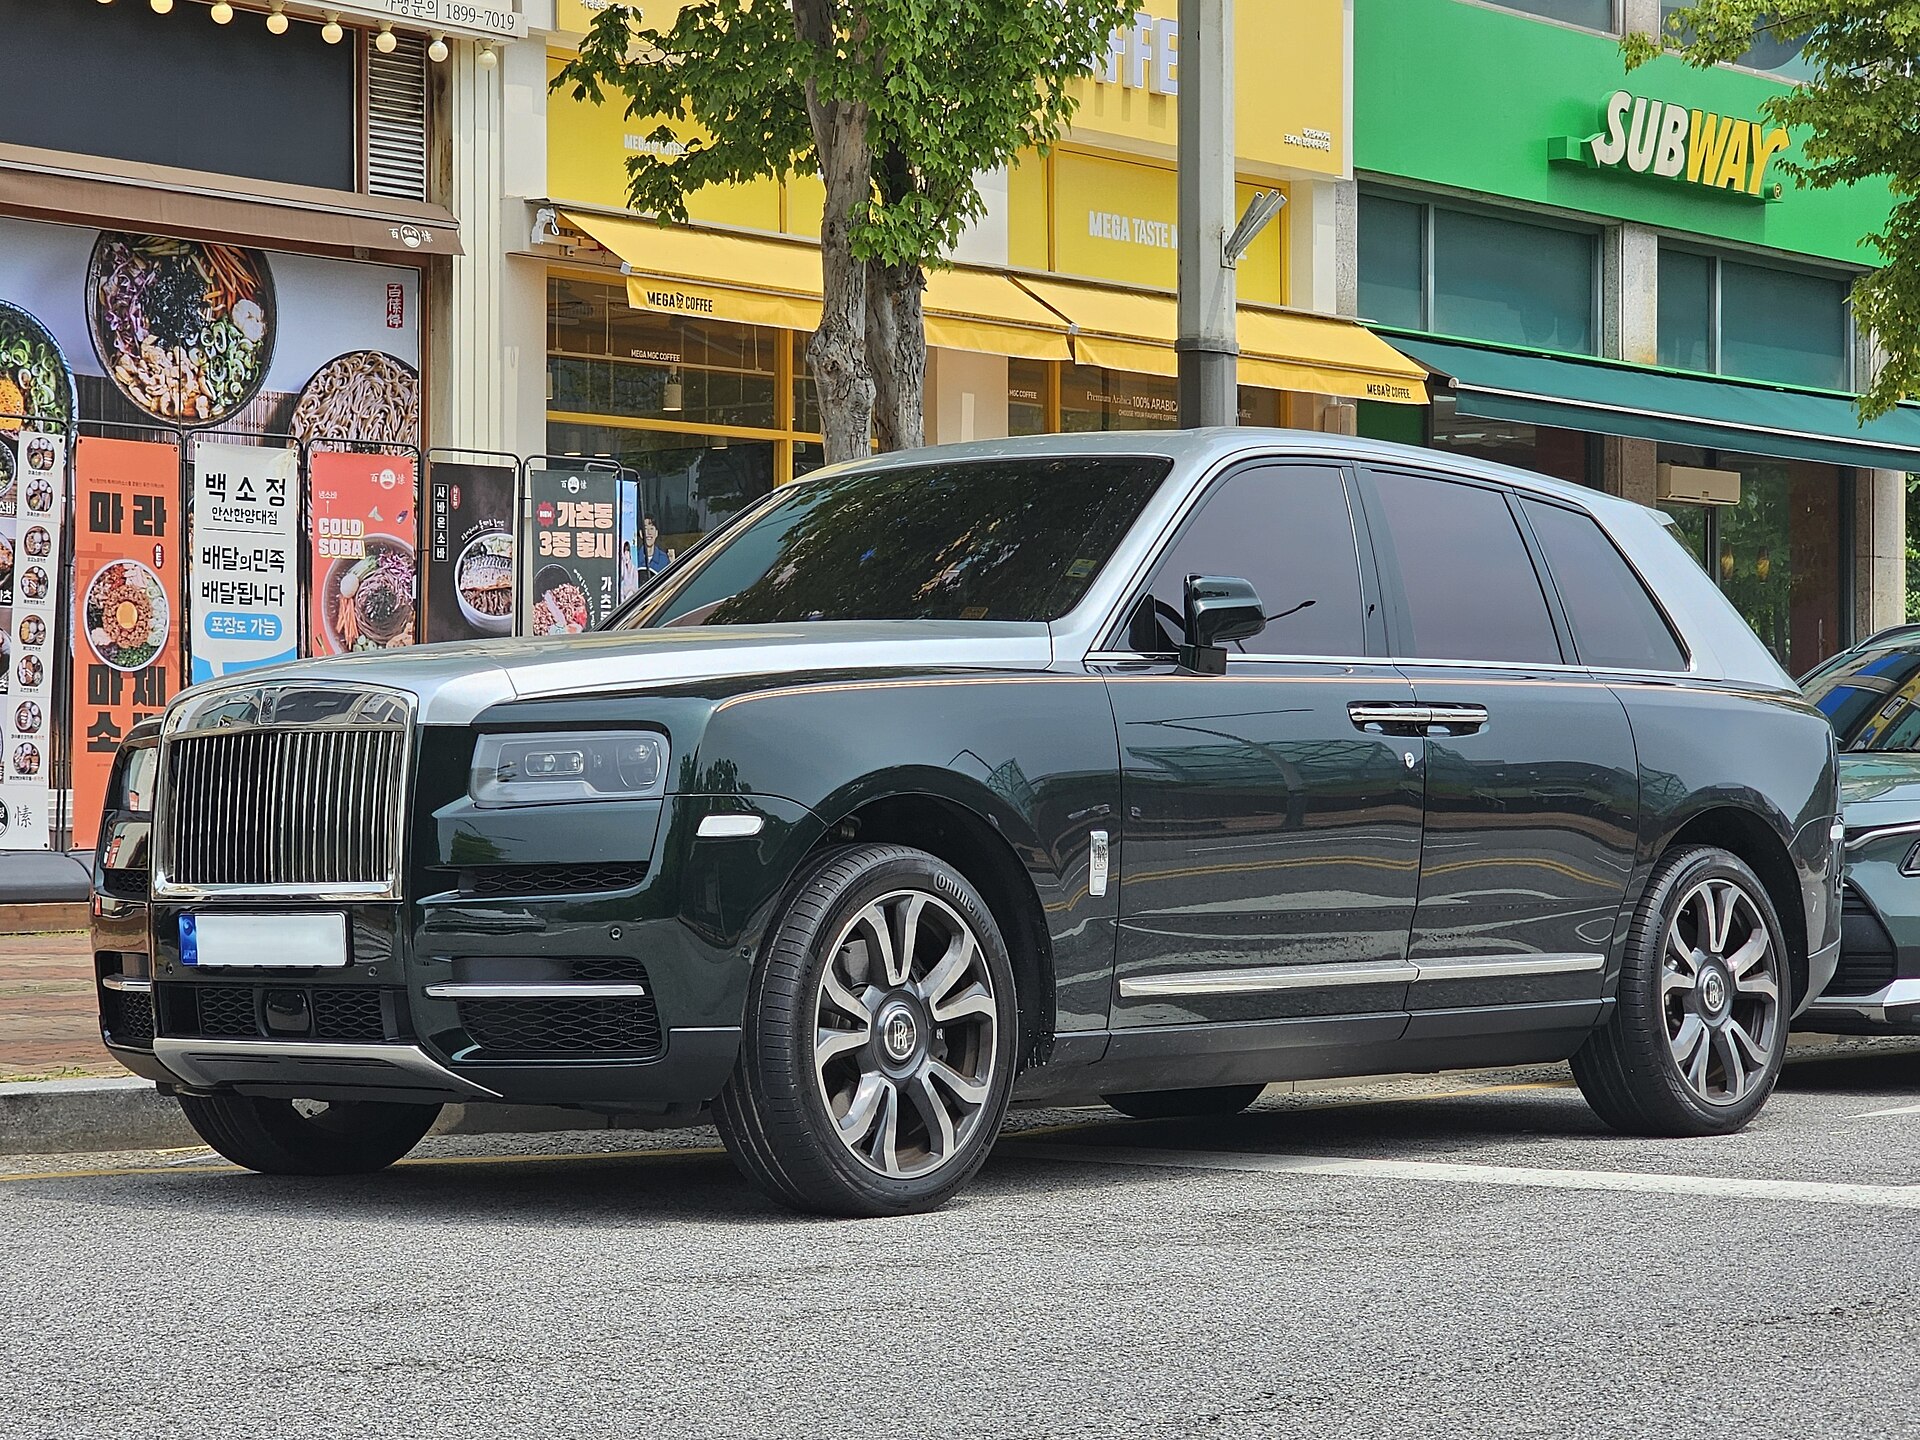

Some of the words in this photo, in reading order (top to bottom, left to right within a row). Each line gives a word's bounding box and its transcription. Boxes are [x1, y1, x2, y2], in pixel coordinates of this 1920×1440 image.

[445, 3, 516, 31] 1899-7019
[1591, 89, 1791, 196] SUBWAY
[1088, 210, 1131, 243] MEGA
[1132, 217, 1169, 249] TASTE
[647, 291, 676, 308] MEGA
[685, 296, 713, 312] COFFEE
[631, 349, 647, 358] MEGA
[660, 353, 680, 362] COFFEE
[1019, 390, 1038, 400] COFFEE
[1087, 391, 1111, 403] Premium
[1132, 396, 1150, 409] 100%
[1366, 383, 1386, 397] MEGA
[1391, 388, 1412, 399] COFFEE
[211, 506, 278, 525] 안산한양대점
[556, 501, 613, 529] 가츠동
[318, 517, 364, 539] COLD
[318, 538, 366, 560] SOBA
[538, 531, 572, 558] 3종
[576, 531, 613, 559] 출시
[202, 545, 286, 573] 배달의민족
[201, 581, 286, 607] 배달됩니다
[210, 616, 247, 635] 포장도
[250, 618, 277, 636] 가능
